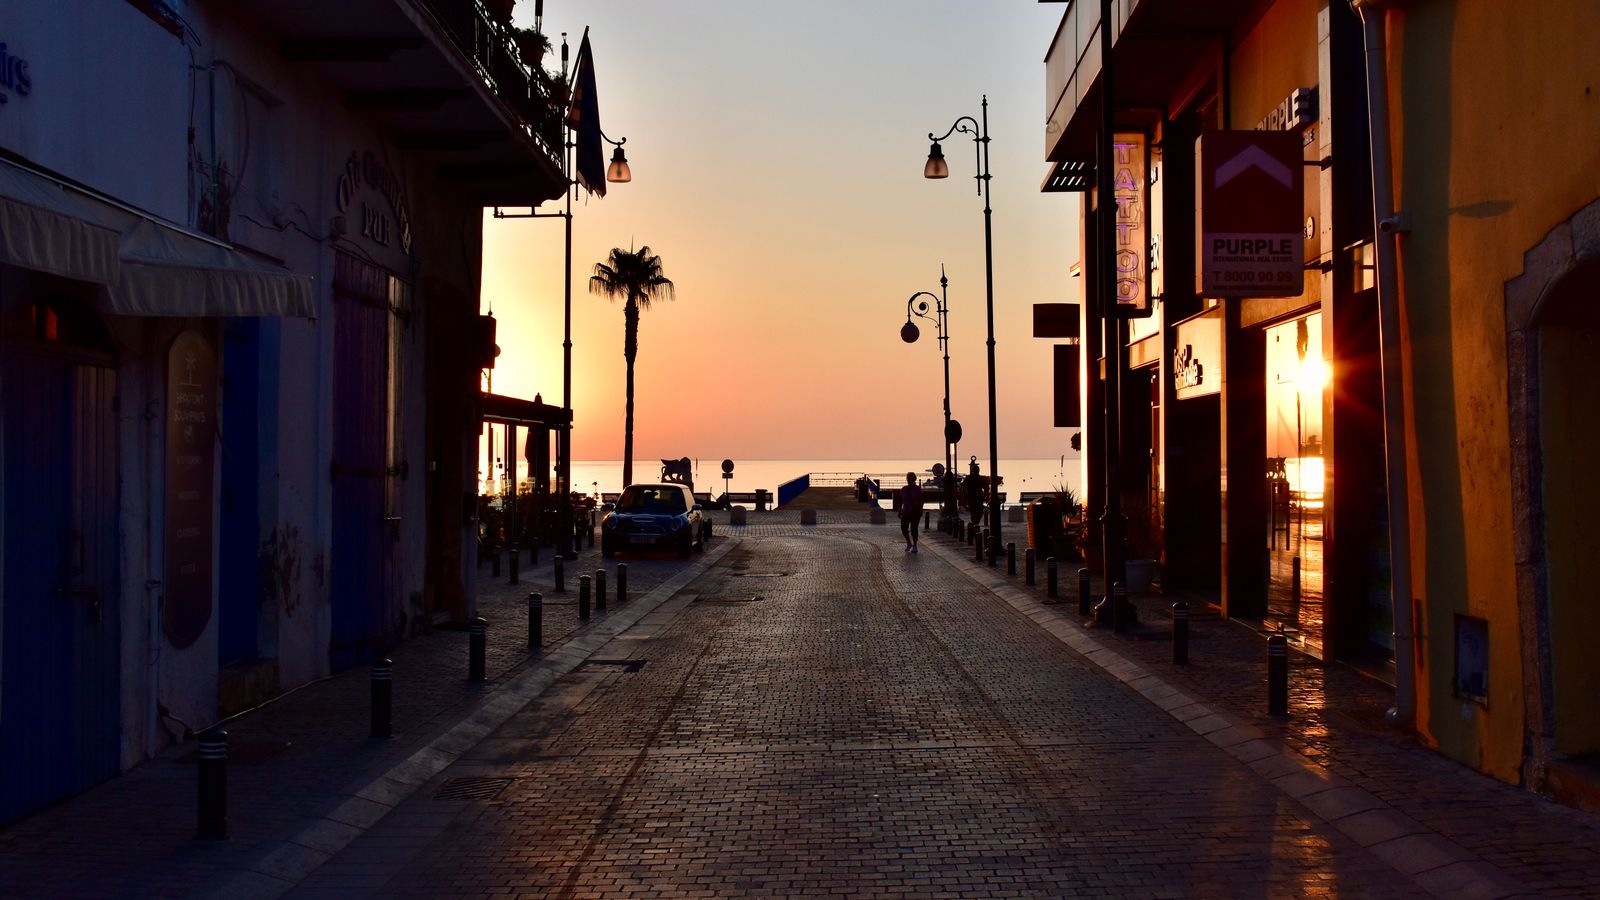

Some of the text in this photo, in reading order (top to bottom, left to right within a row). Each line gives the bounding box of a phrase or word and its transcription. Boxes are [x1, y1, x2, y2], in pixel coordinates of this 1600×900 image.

[1113, 141, 1139, 301] TATTOO
[1213, 239, 1292, 254] PURPLE
[1213, 271, 1292, 282] T 8000 90 99
